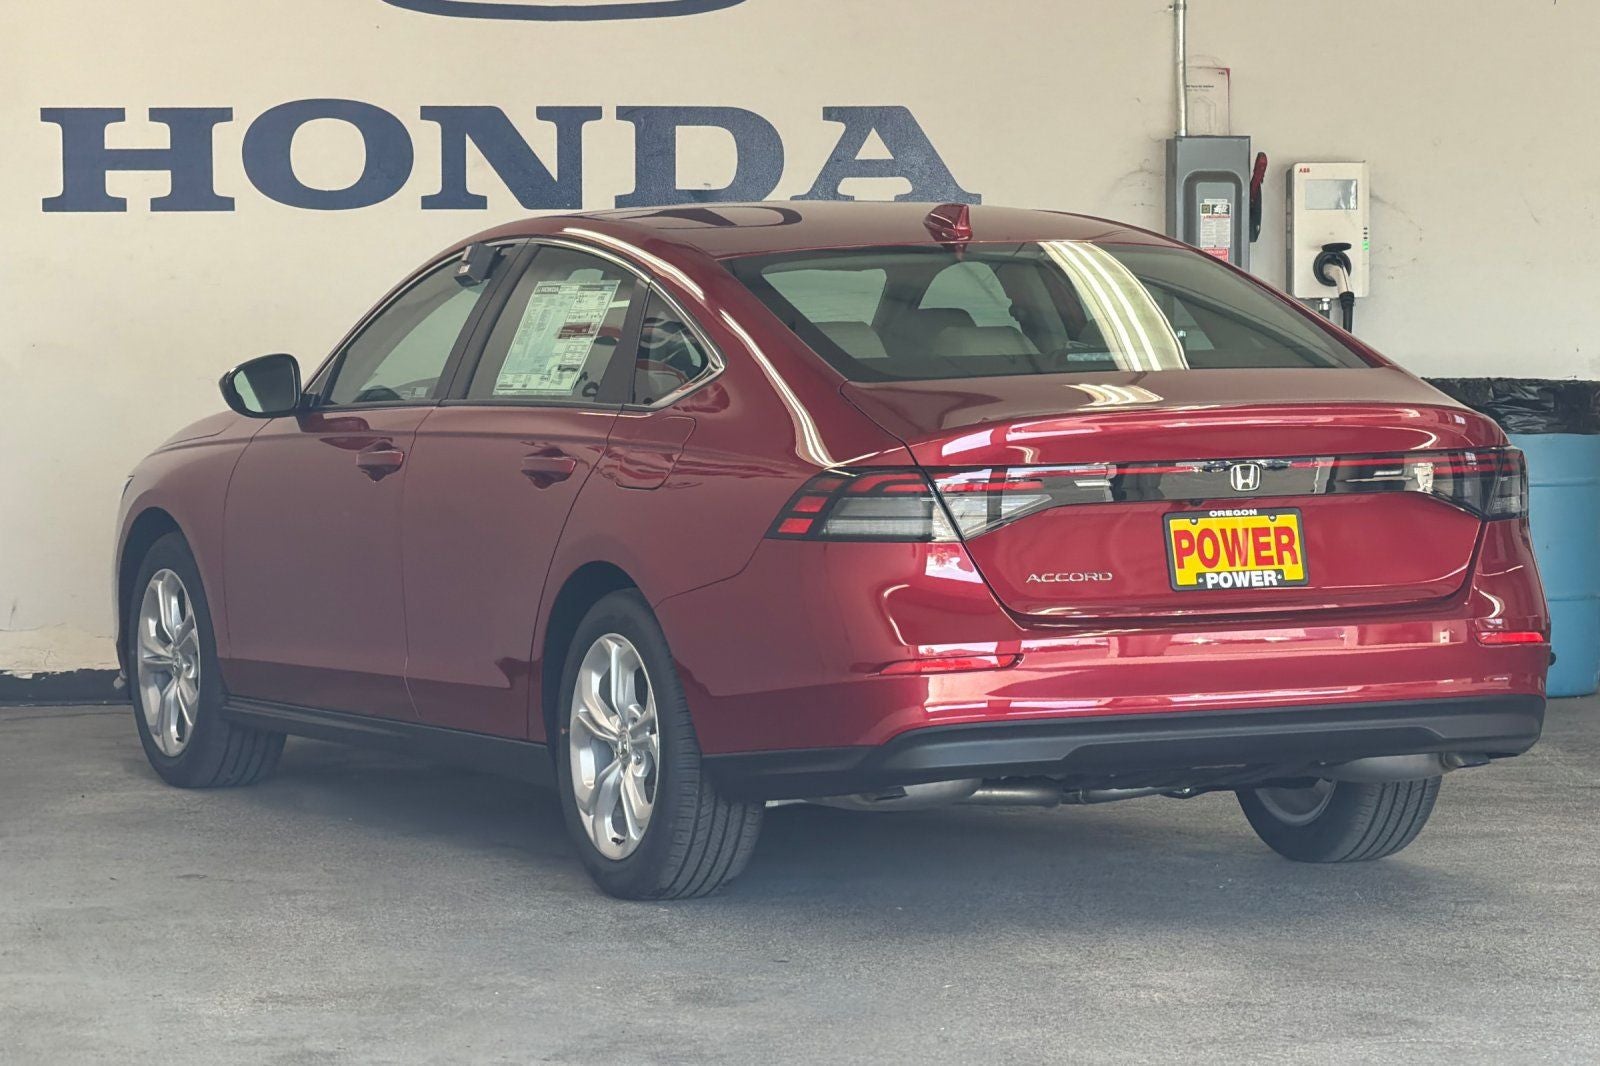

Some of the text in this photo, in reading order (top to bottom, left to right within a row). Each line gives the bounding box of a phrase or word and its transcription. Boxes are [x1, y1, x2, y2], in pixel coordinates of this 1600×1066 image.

[40, 98, 982, 211] HONDA
[1209, 508, 1257, 517] OREGON
[1173, 526, 1298, 569] POWER
[1025, 572, 1113, 583] ACCORD
[1205, 570, 1278, 589] POWER
